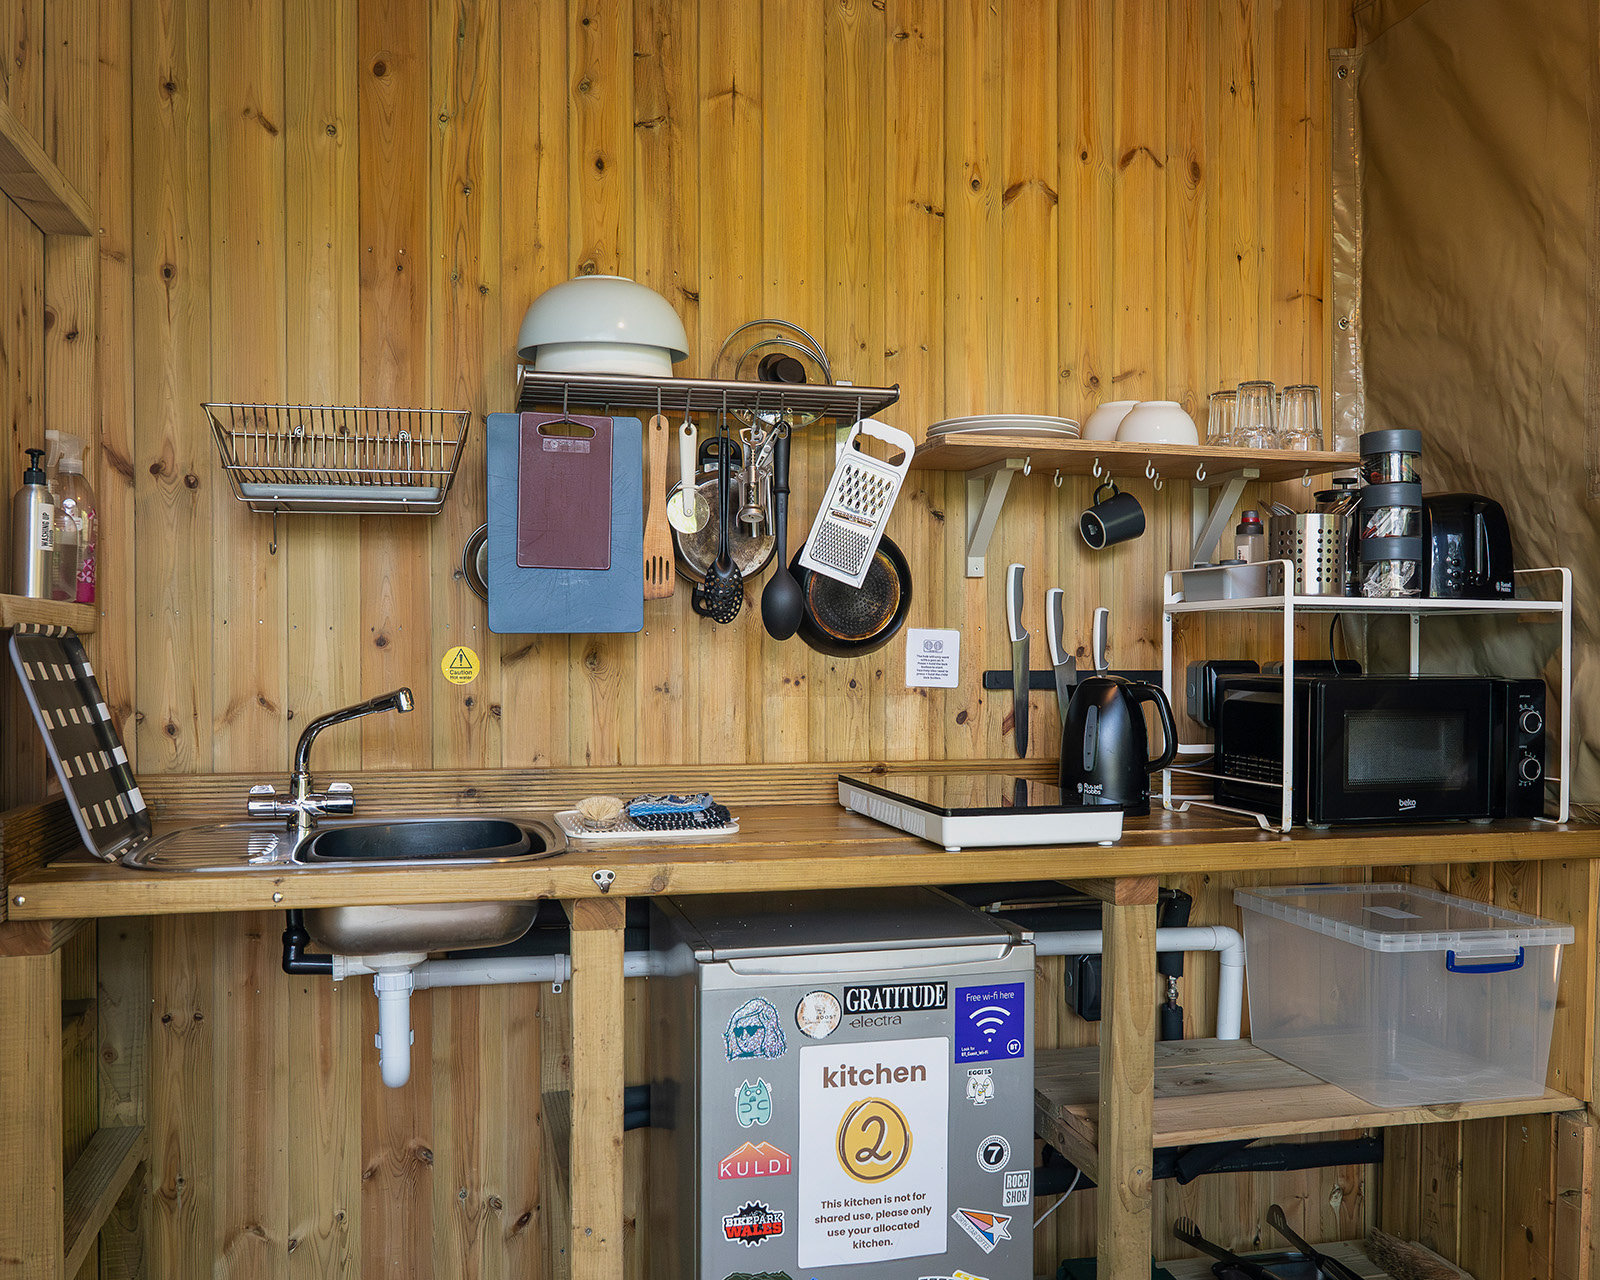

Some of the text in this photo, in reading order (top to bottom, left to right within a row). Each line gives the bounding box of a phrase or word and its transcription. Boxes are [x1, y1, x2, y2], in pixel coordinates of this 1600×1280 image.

[42, 512, 49, 520] UP
[1398, 798, 1417, 807] beko
[846, 984, 946, 1012] GRATITUDE
[966, 991, 1014, 1002] Free wi-fi here
[850, 1015, 902, 1028] electra
[823, 1063, 927, 1088] kitchen
[855, 1115, 892, 1162] 2
[986, 1146, 1001, 1163] 7
[720, 1158, 790, 1177] KULDI
[1006, 1173, 1028, 1188] ROCK
[821, 1192, 926, 1209] This kitchen is not for
[1005, 1190, 1027, 1204] SHOX
[725, 1213, 782, 1228] BIKEPARK
[814, 1212, 850, 1224] shared
[875, 1209, 909, 1221] please
[911, 1205, 932, 1216] only
[726, 1222, 782, 1238] WALES
[827, 1220, 920, 1238] use your allocated
[954, 1213, 991, 1250] NORTH STAR COFFEE
[852, 1238, 894, 1249] kitchen.
